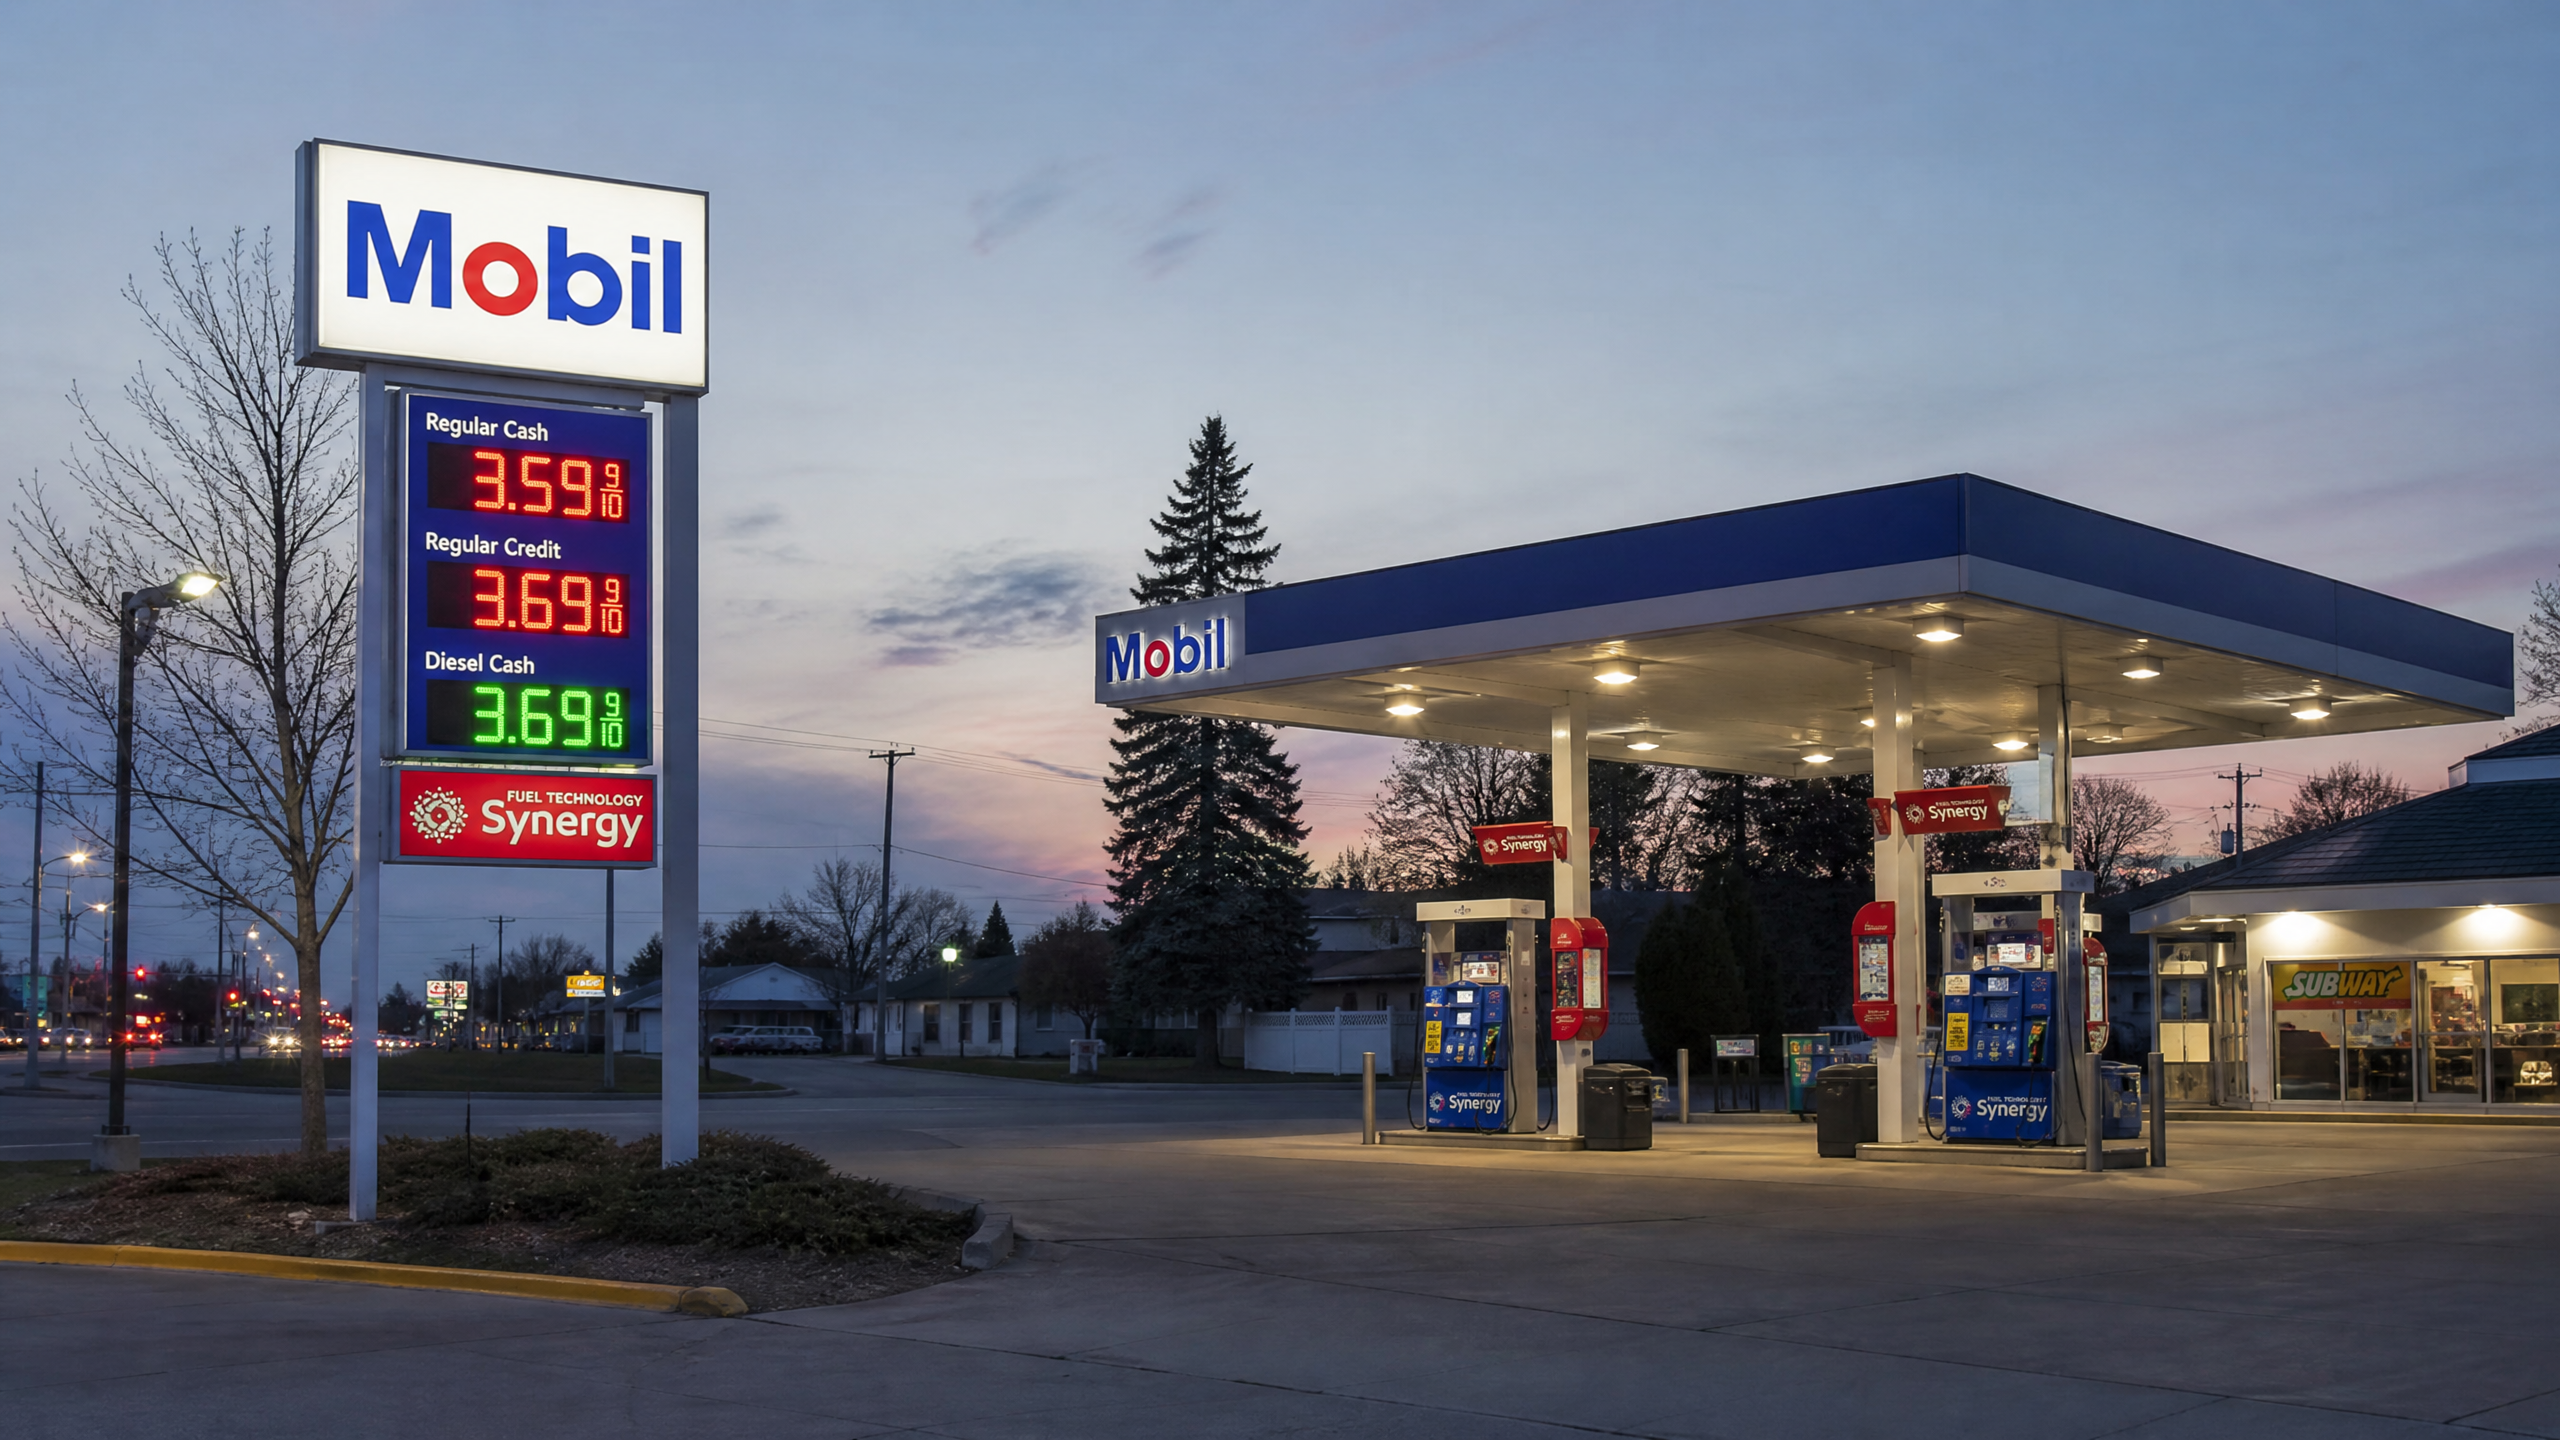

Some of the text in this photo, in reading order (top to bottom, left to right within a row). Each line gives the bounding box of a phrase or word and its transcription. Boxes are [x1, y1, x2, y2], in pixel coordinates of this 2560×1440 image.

[347, 200, 682, 334] Mobil
[426, 412, 549, 441] Regular Cash
[474, 451, 592, 516] 3.59
[425, 532, 561, 559] Regular Credit
[474, 569, 592, 632] 3.69
[425, 651, 535, 675] Diesel Cash
[1106, 616, 1229, 684] Mobil
[474, 686, 592, 747] 3.69
[507, 790, 643, 807] FUEL TECHNOLOGY
[481, 799, 644, 848] Synergy
[1928, 805, 1988, 822] Synergy
[1501, 839, 1547, 853] Synergy
[2283, 966, 2403, 999] SUBWAY
[1449, 1095, 1501, 1114] Synergy
[1977, 1099, 2048, 1122] Synergy
